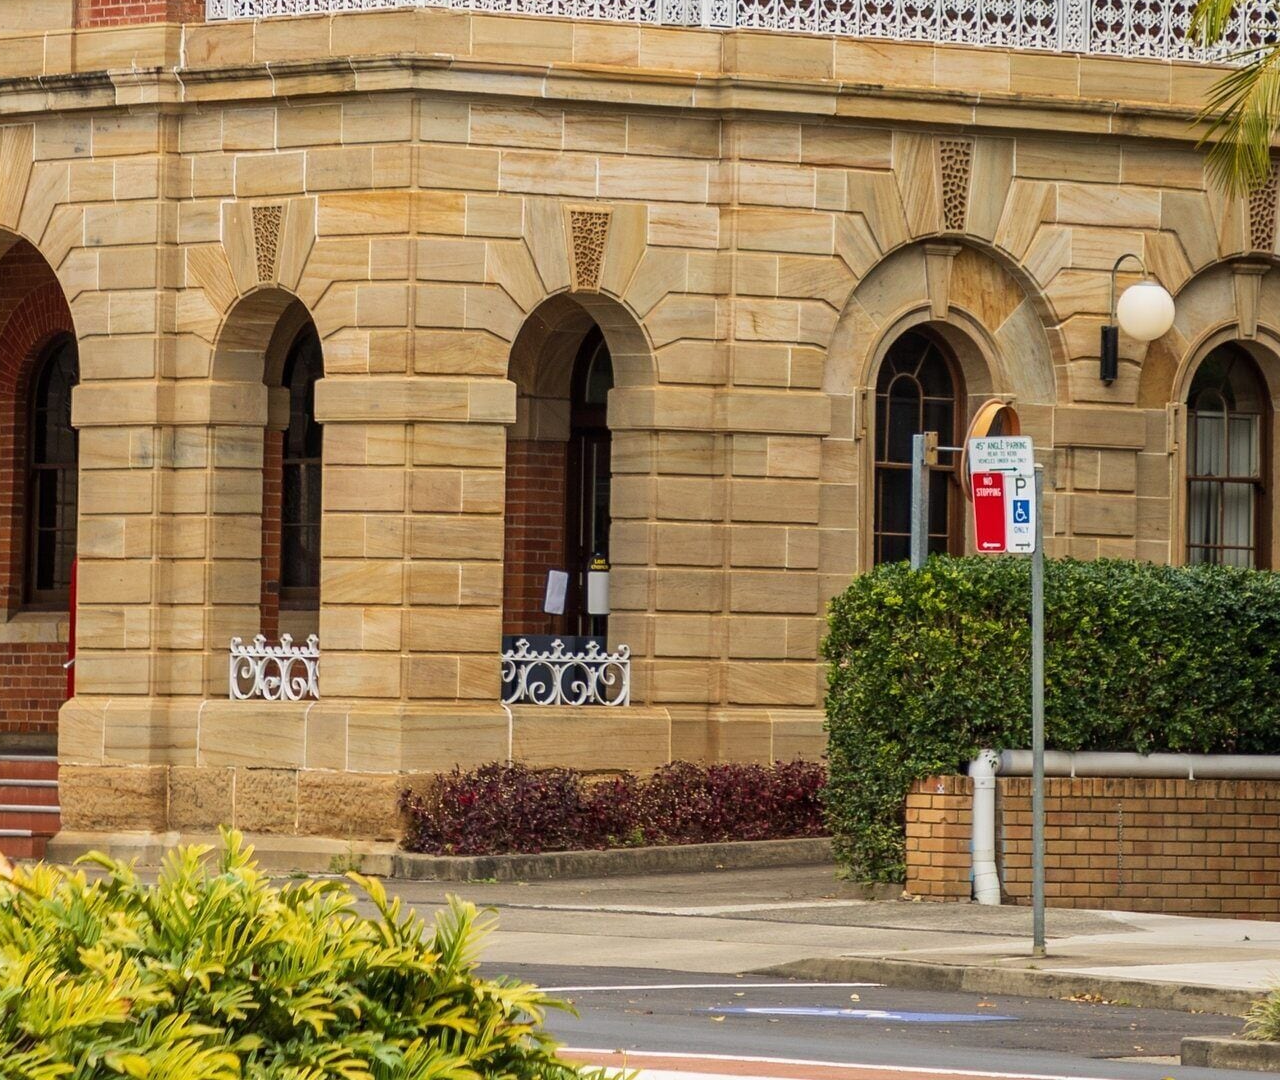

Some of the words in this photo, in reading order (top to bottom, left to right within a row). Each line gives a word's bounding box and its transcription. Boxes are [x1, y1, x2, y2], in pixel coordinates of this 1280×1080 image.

[987, 440, 1003, 450] ANGLE
[1006, 441, 1027, 450] PARKING
[983, 476, 993, 486] NO
[1015, 477, 1026, 496] P
[976, 487, 1002, 497] STOPPING
